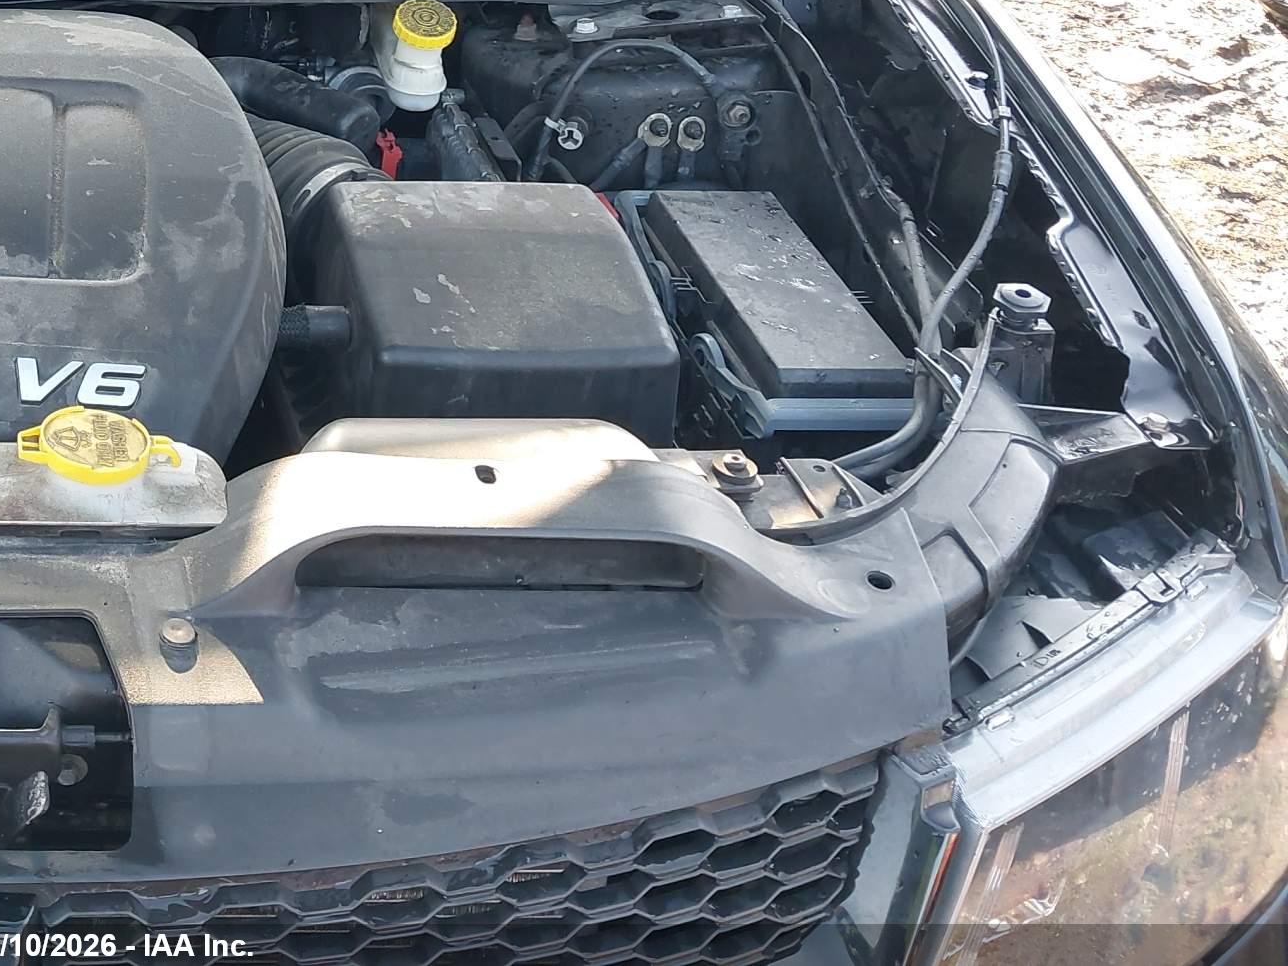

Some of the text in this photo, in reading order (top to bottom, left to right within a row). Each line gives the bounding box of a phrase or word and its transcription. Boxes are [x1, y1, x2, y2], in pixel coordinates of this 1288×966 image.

[15, 356, 147, 409] V6
[91, 414, 114, 467] FLUID ONLY
[110, 420, 130, 462] WASHER
